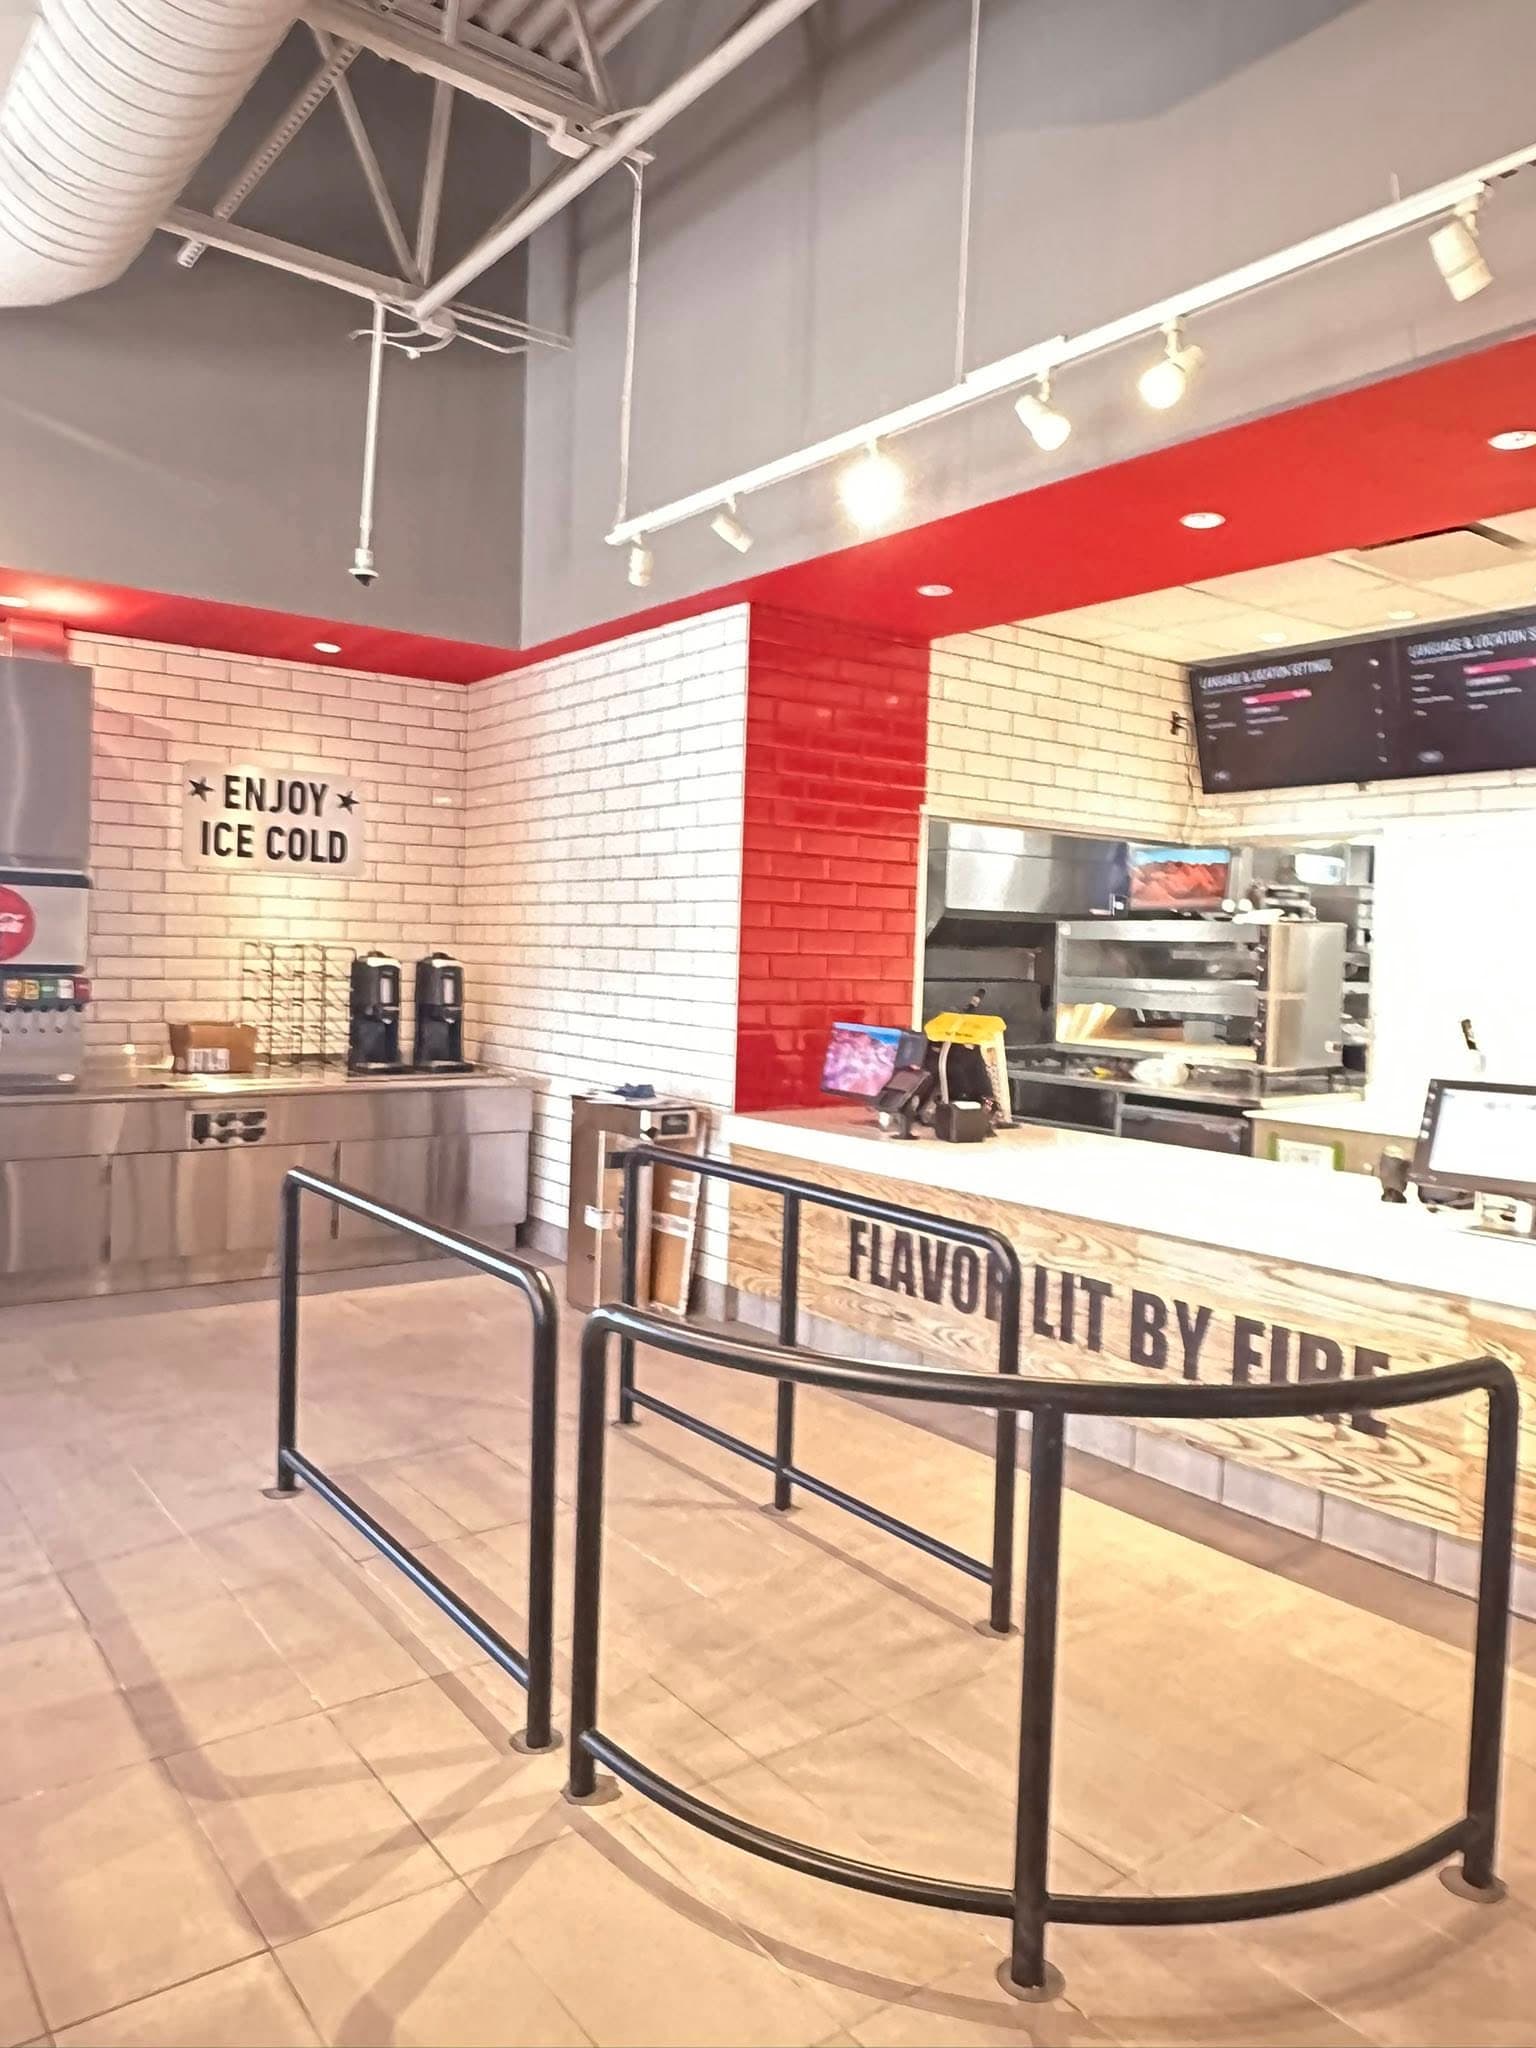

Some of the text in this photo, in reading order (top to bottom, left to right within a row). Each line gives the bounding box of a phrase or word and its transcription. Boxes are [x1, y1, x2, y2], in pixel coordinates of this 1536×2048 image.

[224, 774, 329, 817] ENJOY
[201, 820, 348, 863] ICE COLD
[1033, 1264, 1113, 1353] LIT
[1130, 1289, 1213, 1380] BY
